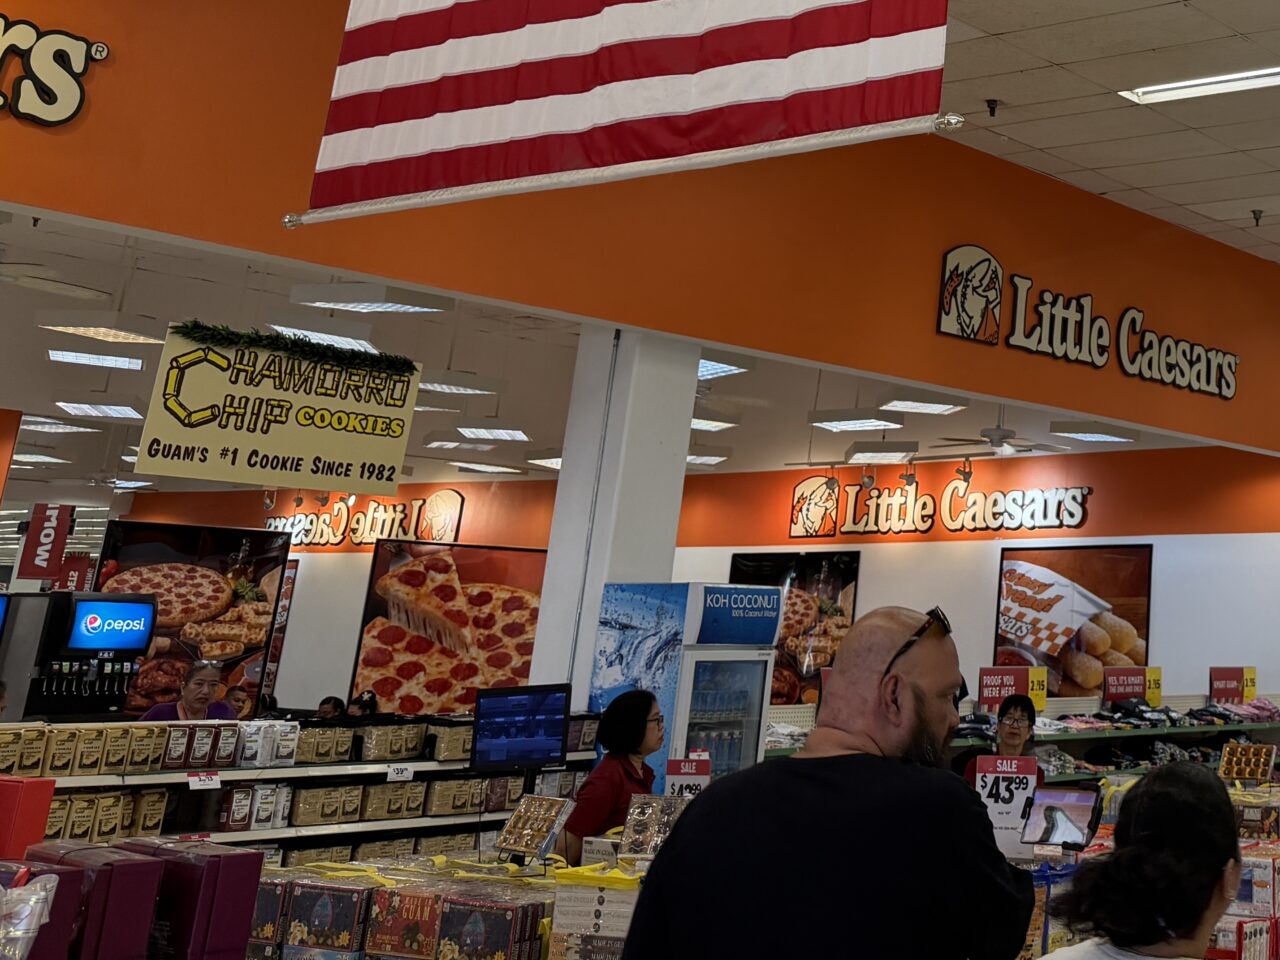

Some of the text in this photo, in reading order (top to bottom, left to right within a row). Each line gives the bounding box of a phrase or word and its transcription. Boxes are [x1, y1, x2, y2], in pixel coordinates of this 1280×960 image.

[1008, 274, 1239, 399] Little Caesars
[163, 346, 410, 428] CHAMORRO
[296, 406, 404, 438] COOKIES
[147, 438, 396, 482] GUAM'S #1 COOKIE SINCE 1982
[840, 479, 1085, 534] Little Caesars
[706, 594, 778, 608] KOH COCONUT
[104, 618, 144, 632] pepsi
[983, 676, 1001, 686] PROOF
[1003, 676, 1014, 686] YOU
[983, 687, 999, 697] WERE
[681, 762, 696, 773] SALE
[997, 760, 1018, 771] SALE
[403, 904, 431, 920] GUAM
